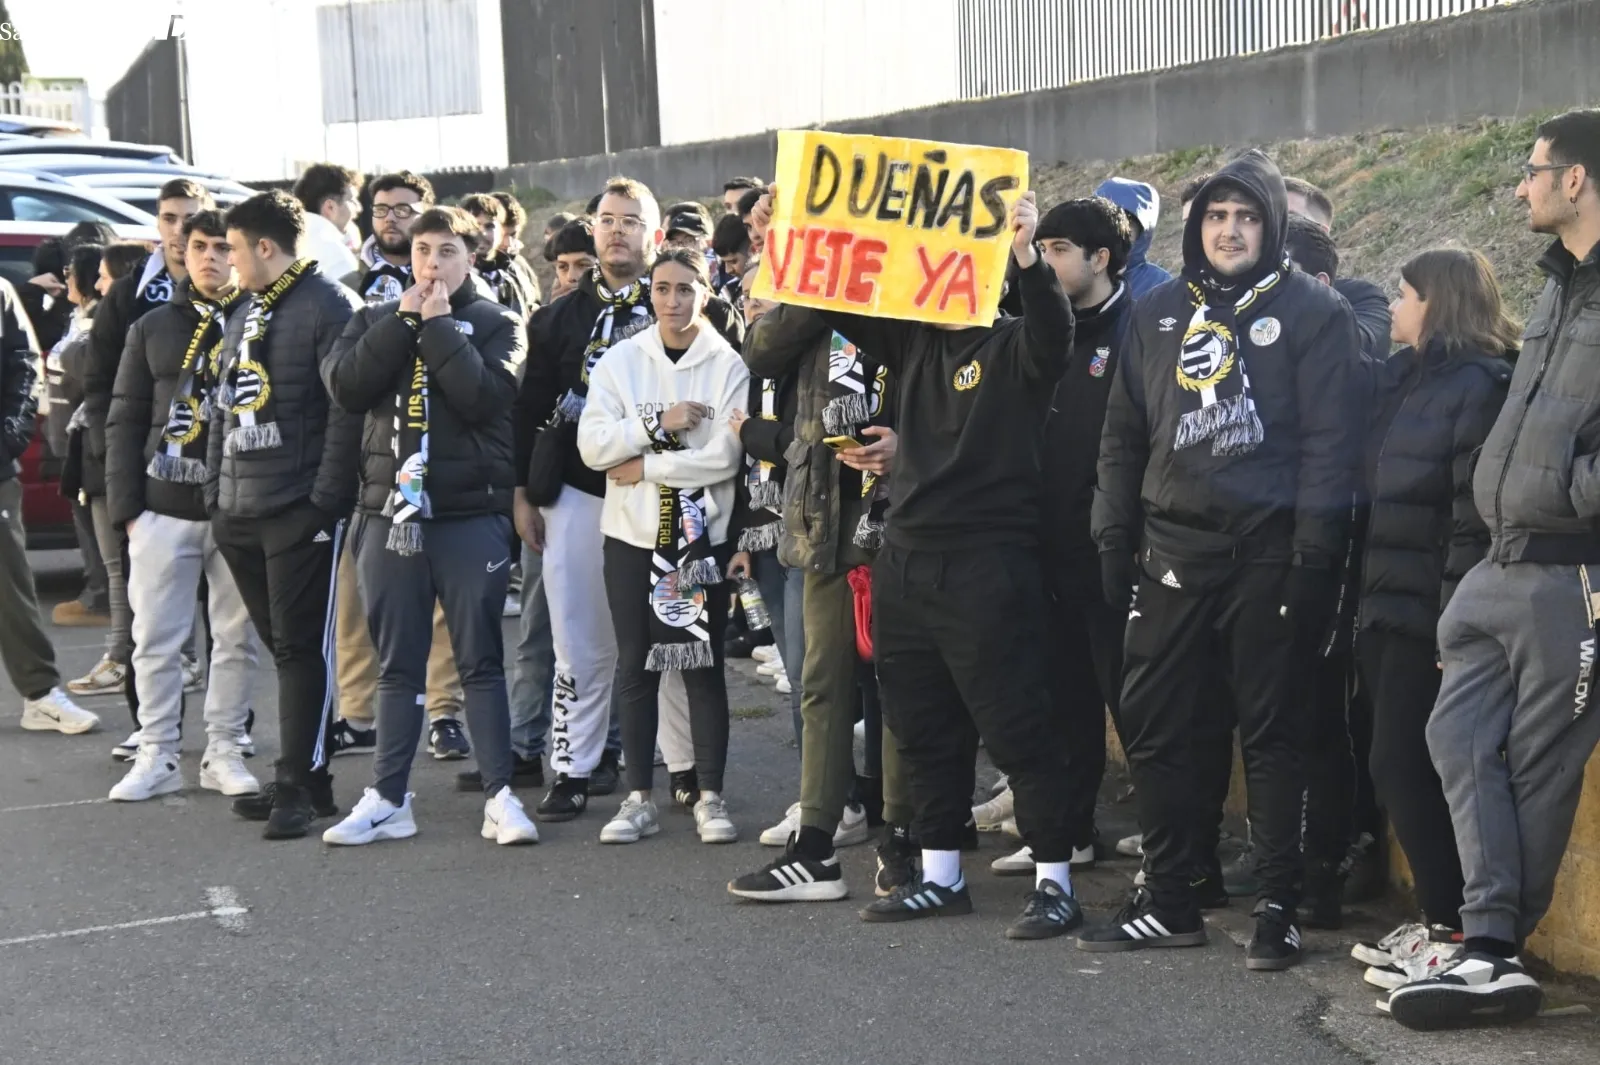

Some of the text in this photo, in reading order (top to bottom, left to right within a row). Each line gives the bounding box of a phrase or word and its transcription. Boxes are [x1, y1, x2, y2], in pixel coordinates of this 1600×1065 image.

[805, 143, 1020, 239] DUEÑAS
[766, 228, 978, 316] VETE YA
[658, 498, 674, 548] ENTERO.
